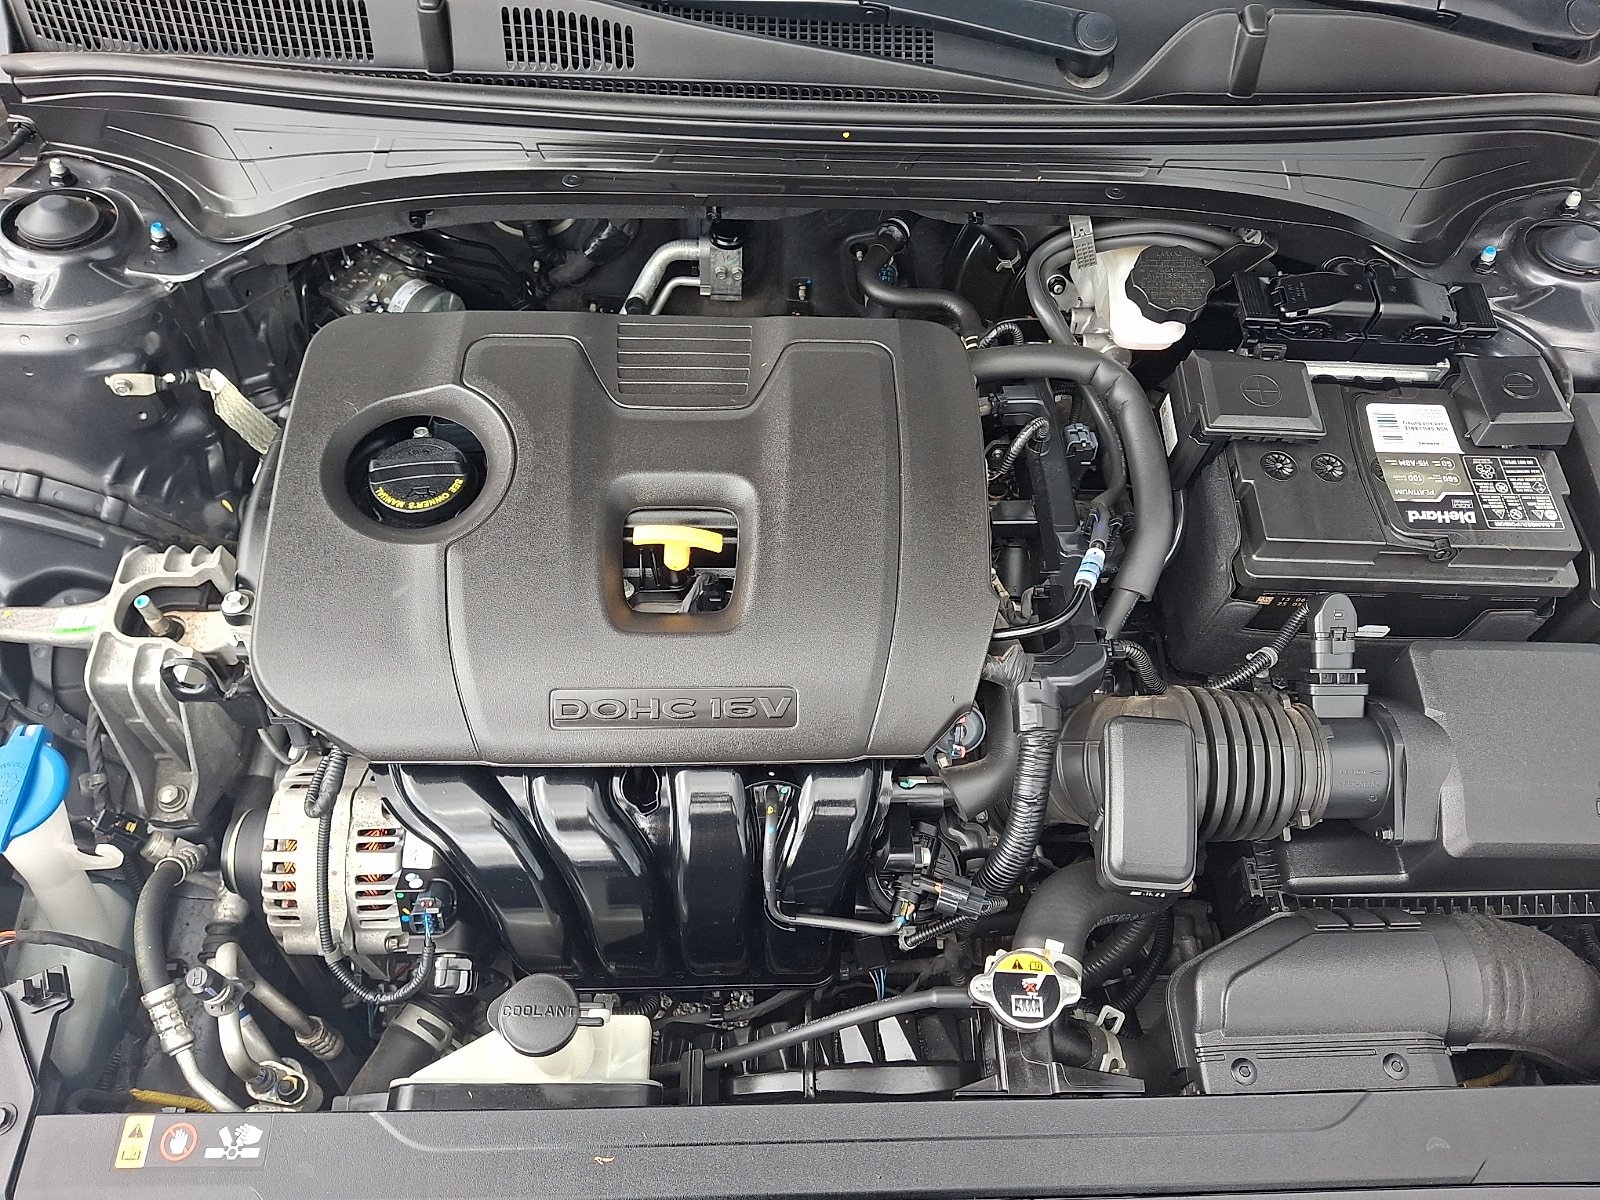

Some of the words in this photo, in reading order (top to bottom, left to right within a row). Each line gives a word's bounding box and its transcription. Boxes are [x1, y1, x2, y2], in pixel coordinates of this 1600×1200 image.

[448, 478, 463, 493] SEE
[1394, 488, 1435, 496] PLATINUM
[375, 487, 405, 508] MANUAL
[408, 492, 449, 509] OWNER'S
[1407, 510, 1477, 524] DieHard
[553, 697, 697, 721] DOHC
[709, 697, 793, 719] 16V
[503, 1004, 577, 1018] COOLANT
